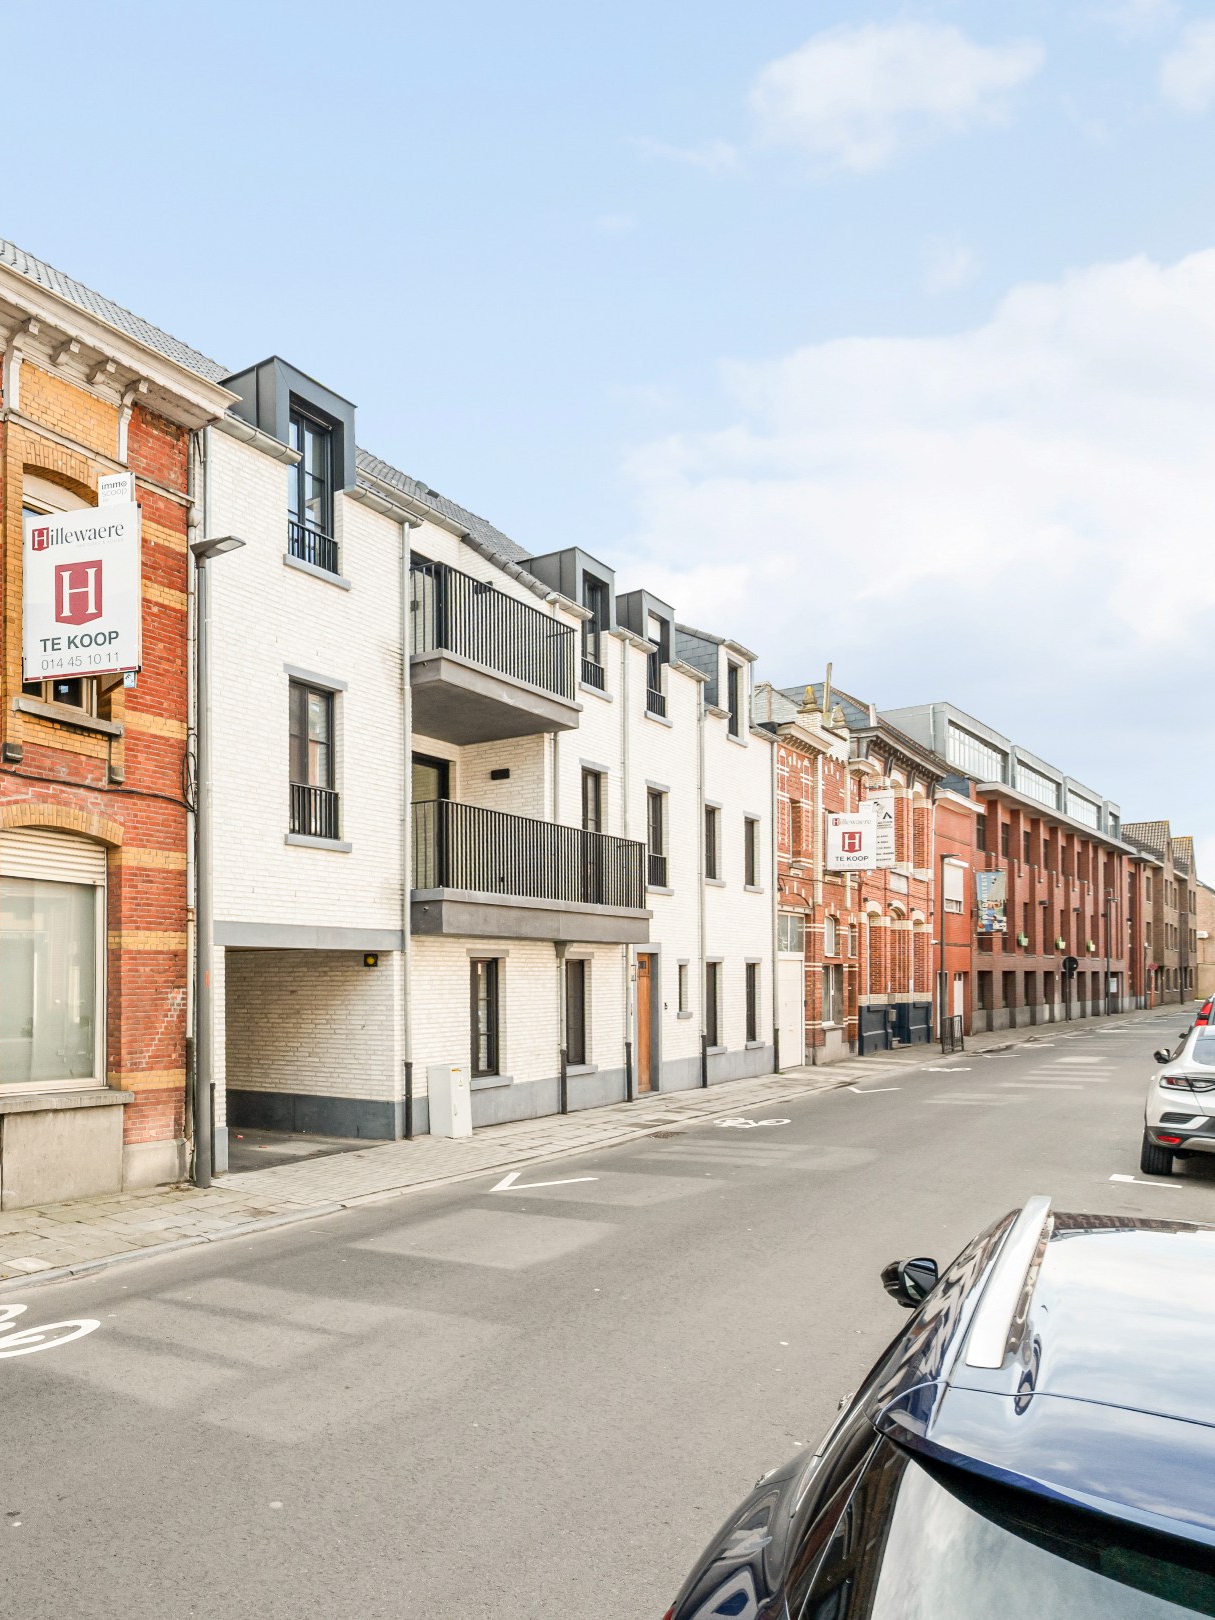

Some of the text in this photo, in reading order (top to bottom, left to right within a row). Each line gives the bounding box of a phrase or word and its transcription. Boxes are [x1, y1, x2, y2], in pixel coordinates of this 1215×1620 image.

[101, 487, 128, 498] scoop
[33, 523, 124, 549] Hillewaere
[60, 567, 98, 617] H
[40, 630, 119, 652] TE KOOP
[41, 651, 119, 671] 014 45 10 11
[843, 833, 861, 851] H
